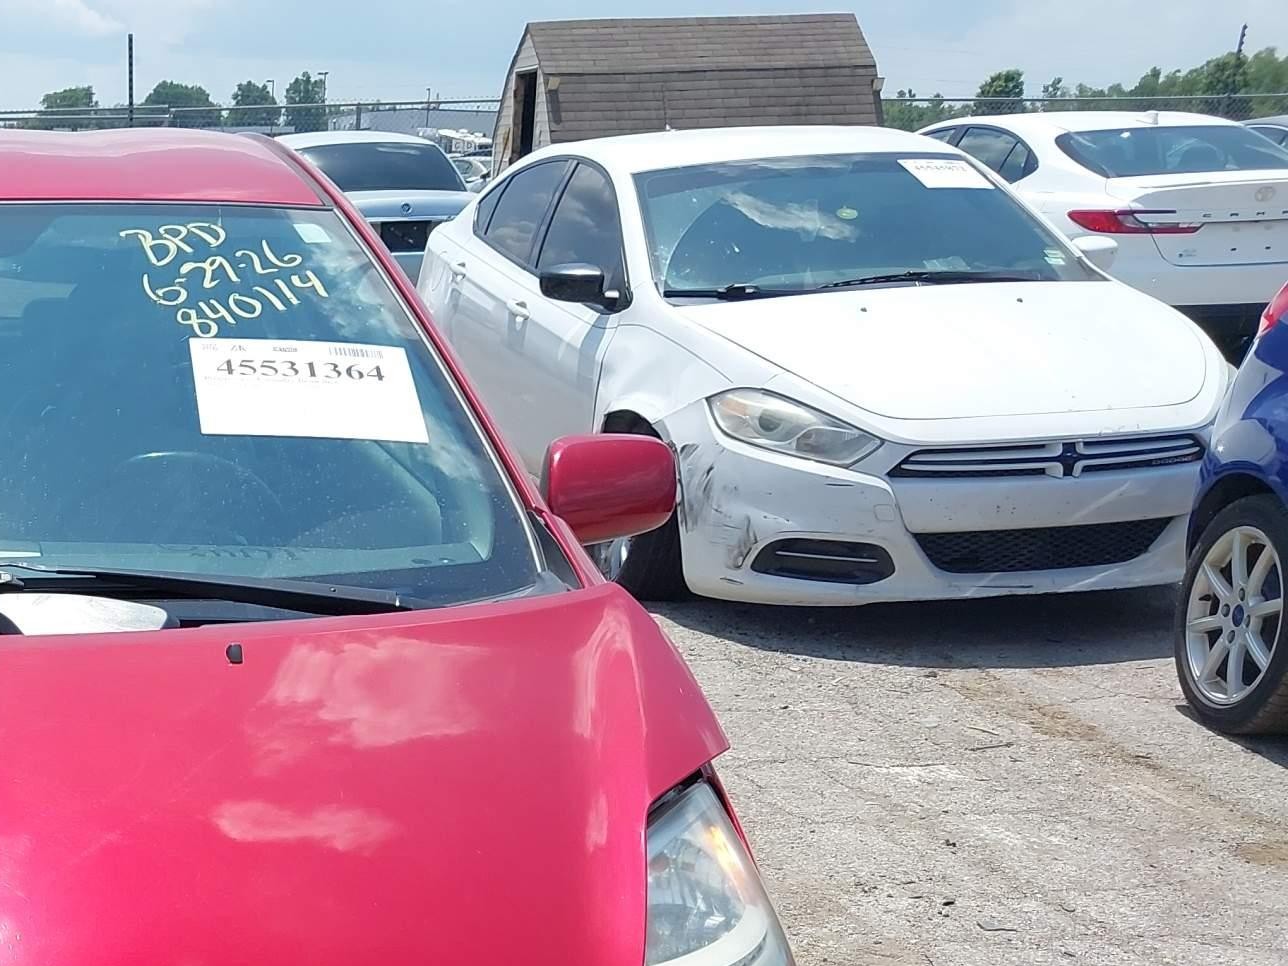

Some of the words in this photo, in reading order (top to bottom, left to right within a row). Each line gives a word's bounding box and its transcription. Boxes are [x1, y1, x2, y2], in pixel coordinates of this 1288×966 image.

[119, 222, 226, 266] BPD
[177, 270, 329, 338] 840114
[216, 358, 386, 381] 45531364
